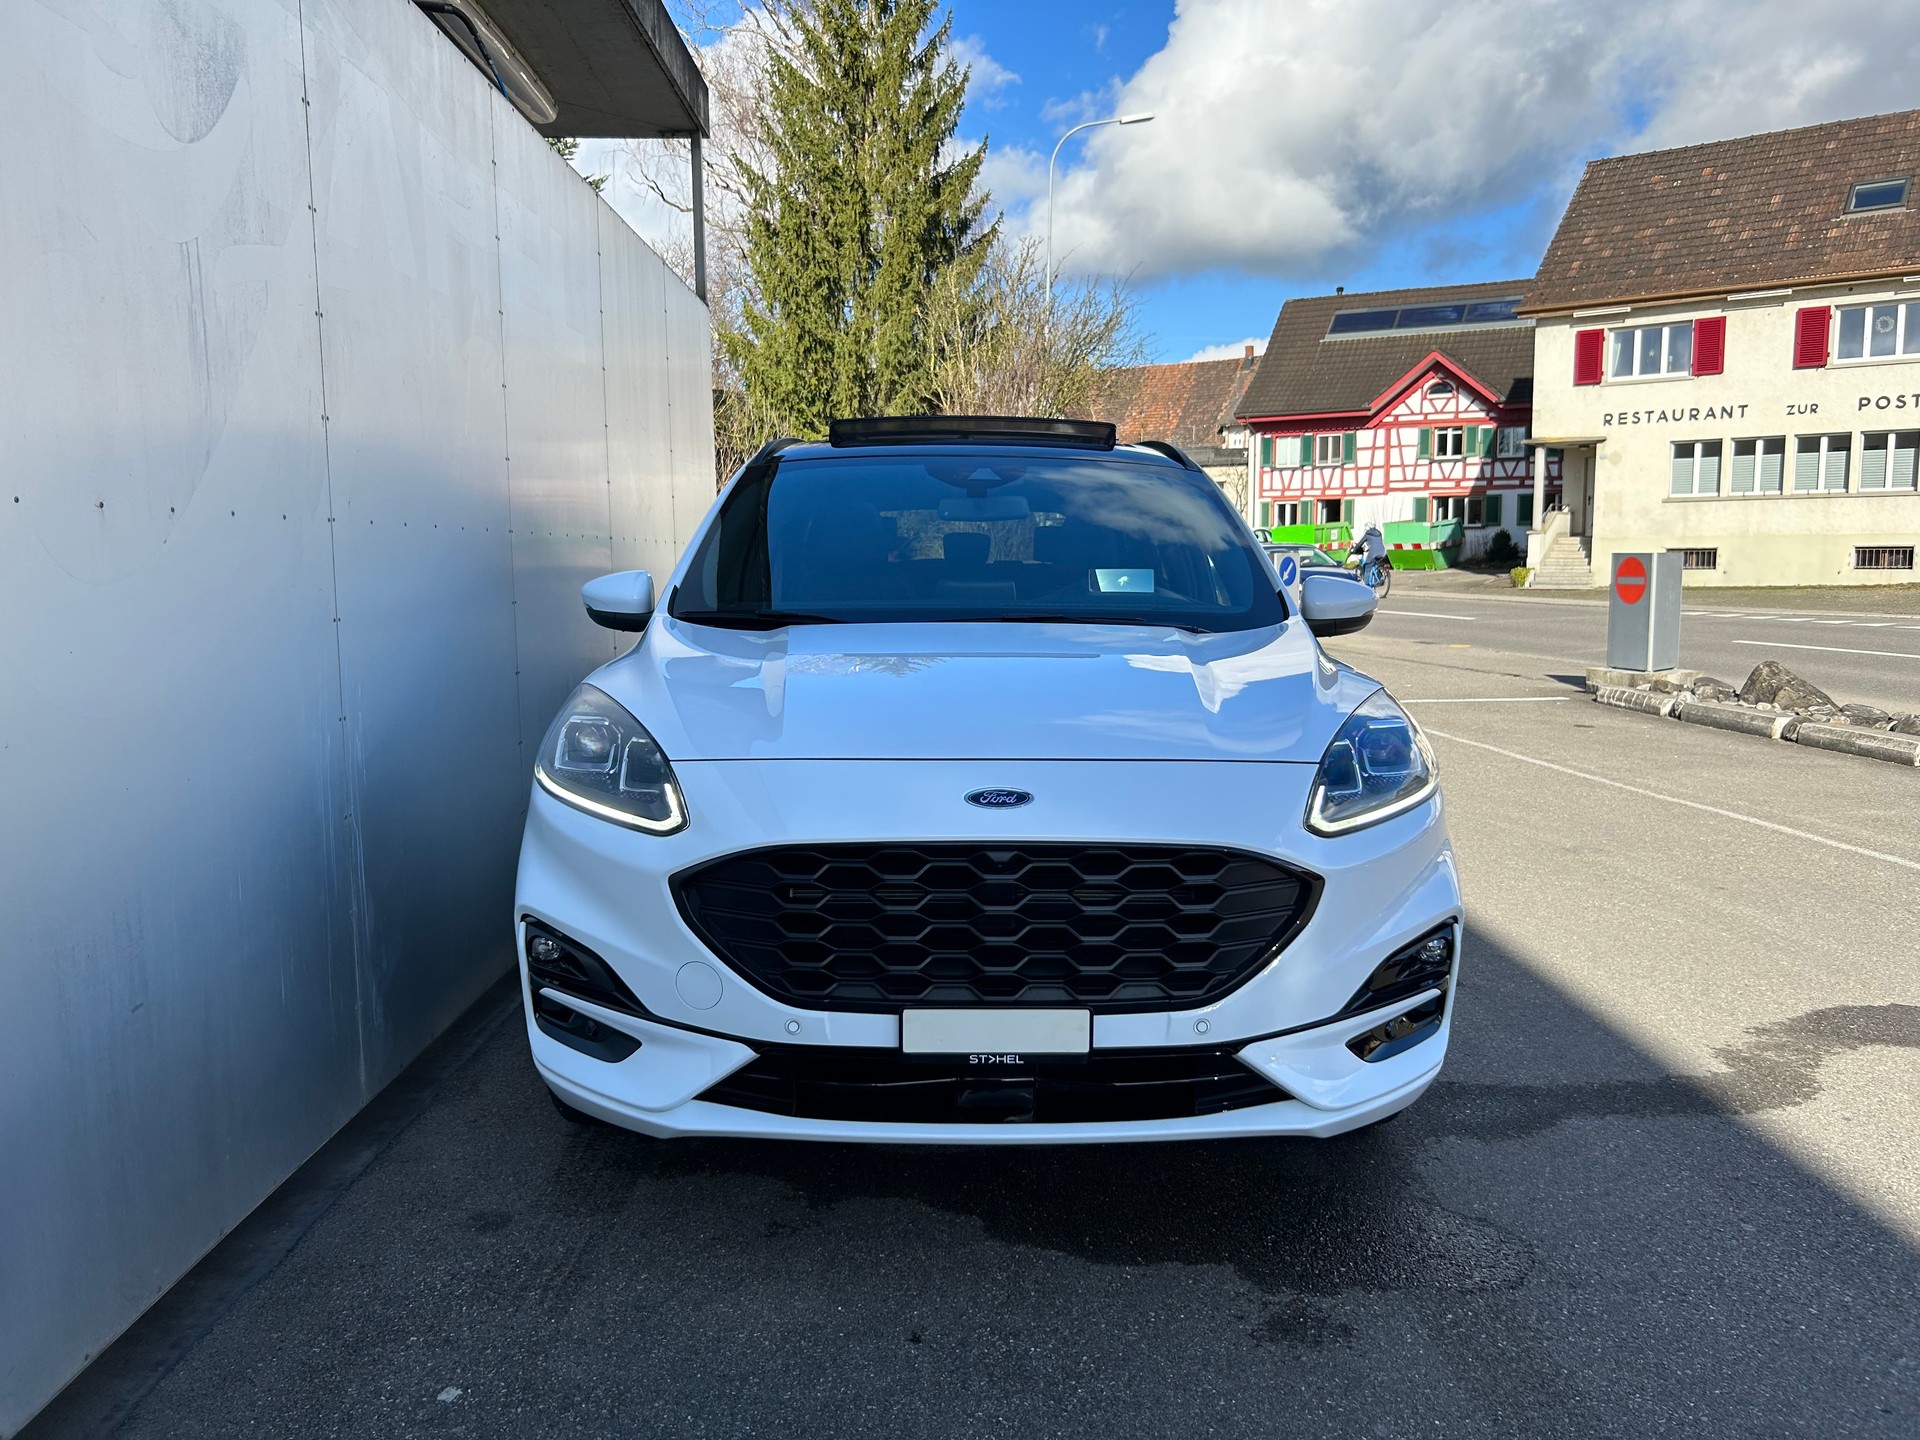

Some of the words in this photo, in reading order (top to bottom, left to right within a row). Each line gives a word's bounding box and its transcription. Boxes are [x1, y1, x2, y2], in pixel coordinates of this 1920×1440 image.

[1603, 404, 1748, 426] RESTAURANT
[1786, 403, 1819, 416] ZUR
[1858, 394, 1920, 411] POST
[979, 790, 1018, 804] Ford
